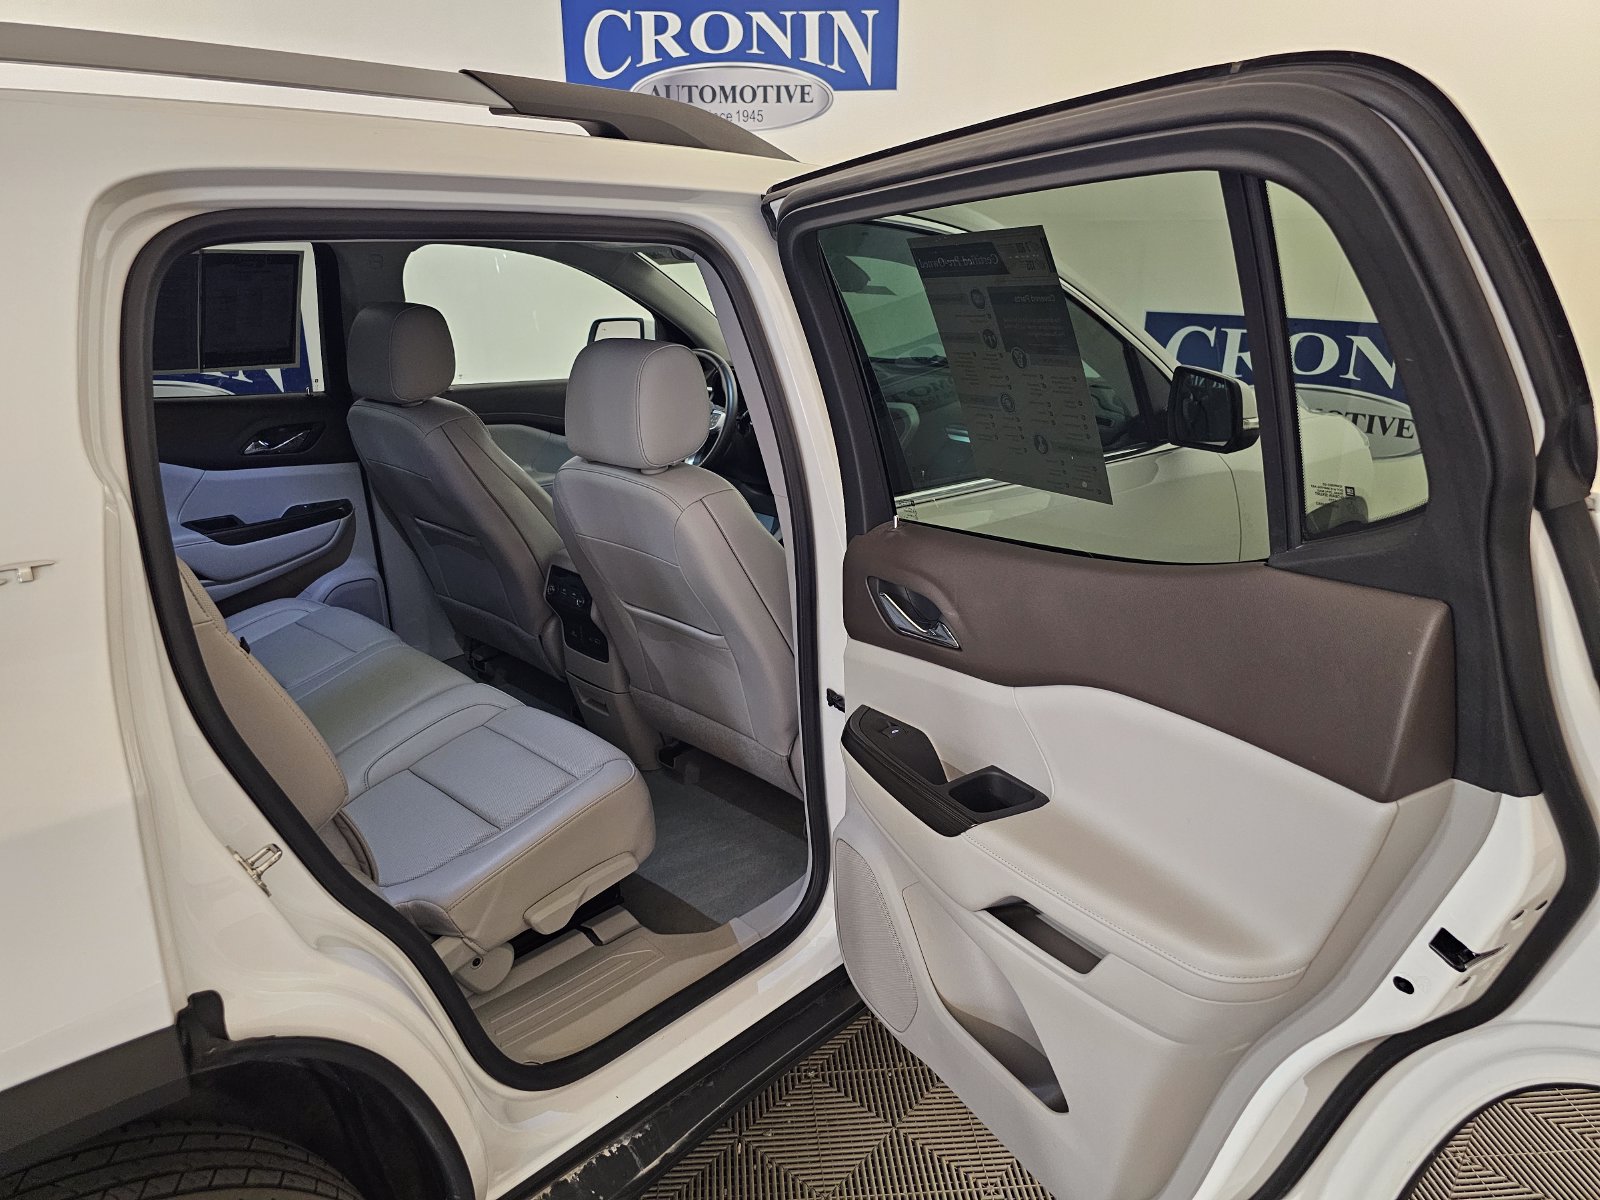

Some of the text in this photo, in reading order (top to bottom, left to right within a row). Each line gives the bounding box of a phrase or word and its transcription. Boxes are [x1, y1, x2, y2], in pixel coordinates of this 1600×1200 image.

[583, 9, 880, 86] CRONIN
[651, 84, 814, 105] AUTOMOTIVE
[736, 109, 764, 123] 1945
